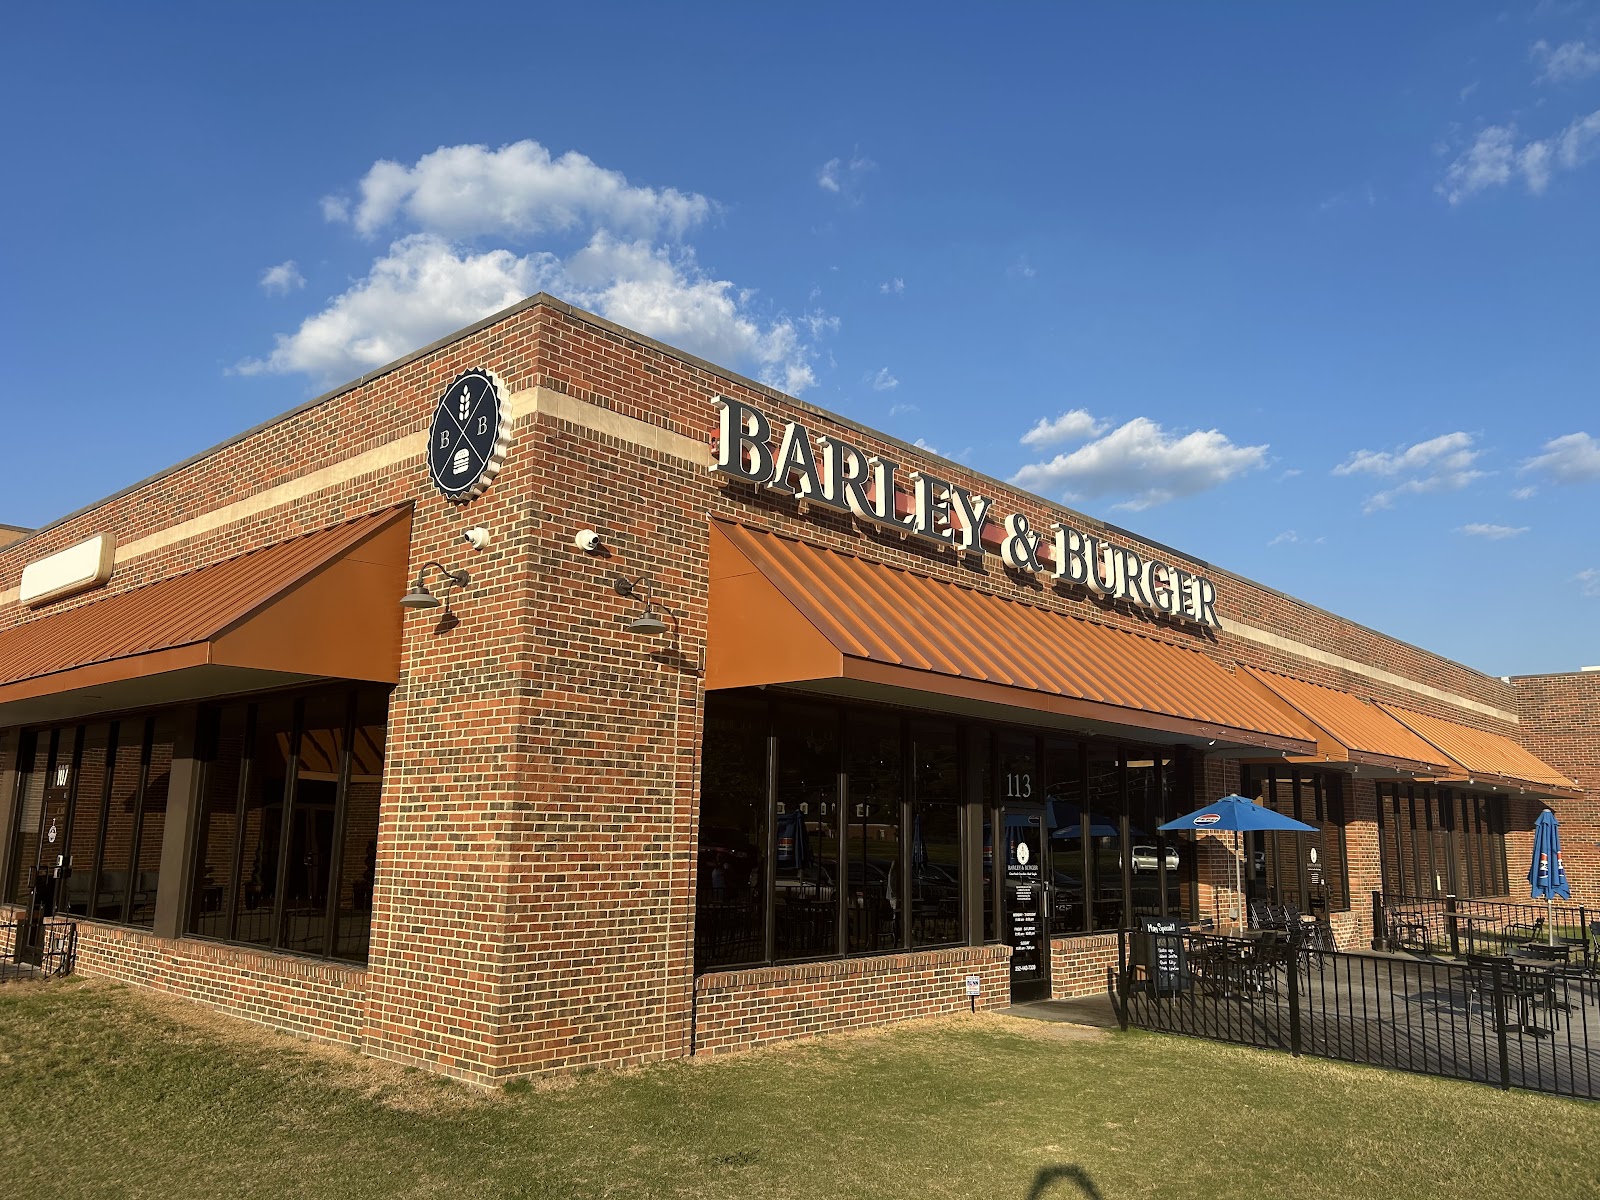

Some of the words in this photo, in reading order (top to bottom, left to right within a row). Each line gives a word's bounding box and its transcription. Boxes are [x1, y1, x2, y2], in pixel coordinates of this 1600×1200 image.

[440, 430, 450, 450] B
[476, 416, 488, 436] B
[708, 395, 992, 554] BARLEY
[1001, 513, 1044, 574] &
[1050, 522, 1222, 630] BURGER
[1007, 773, 1031, 798] 113
